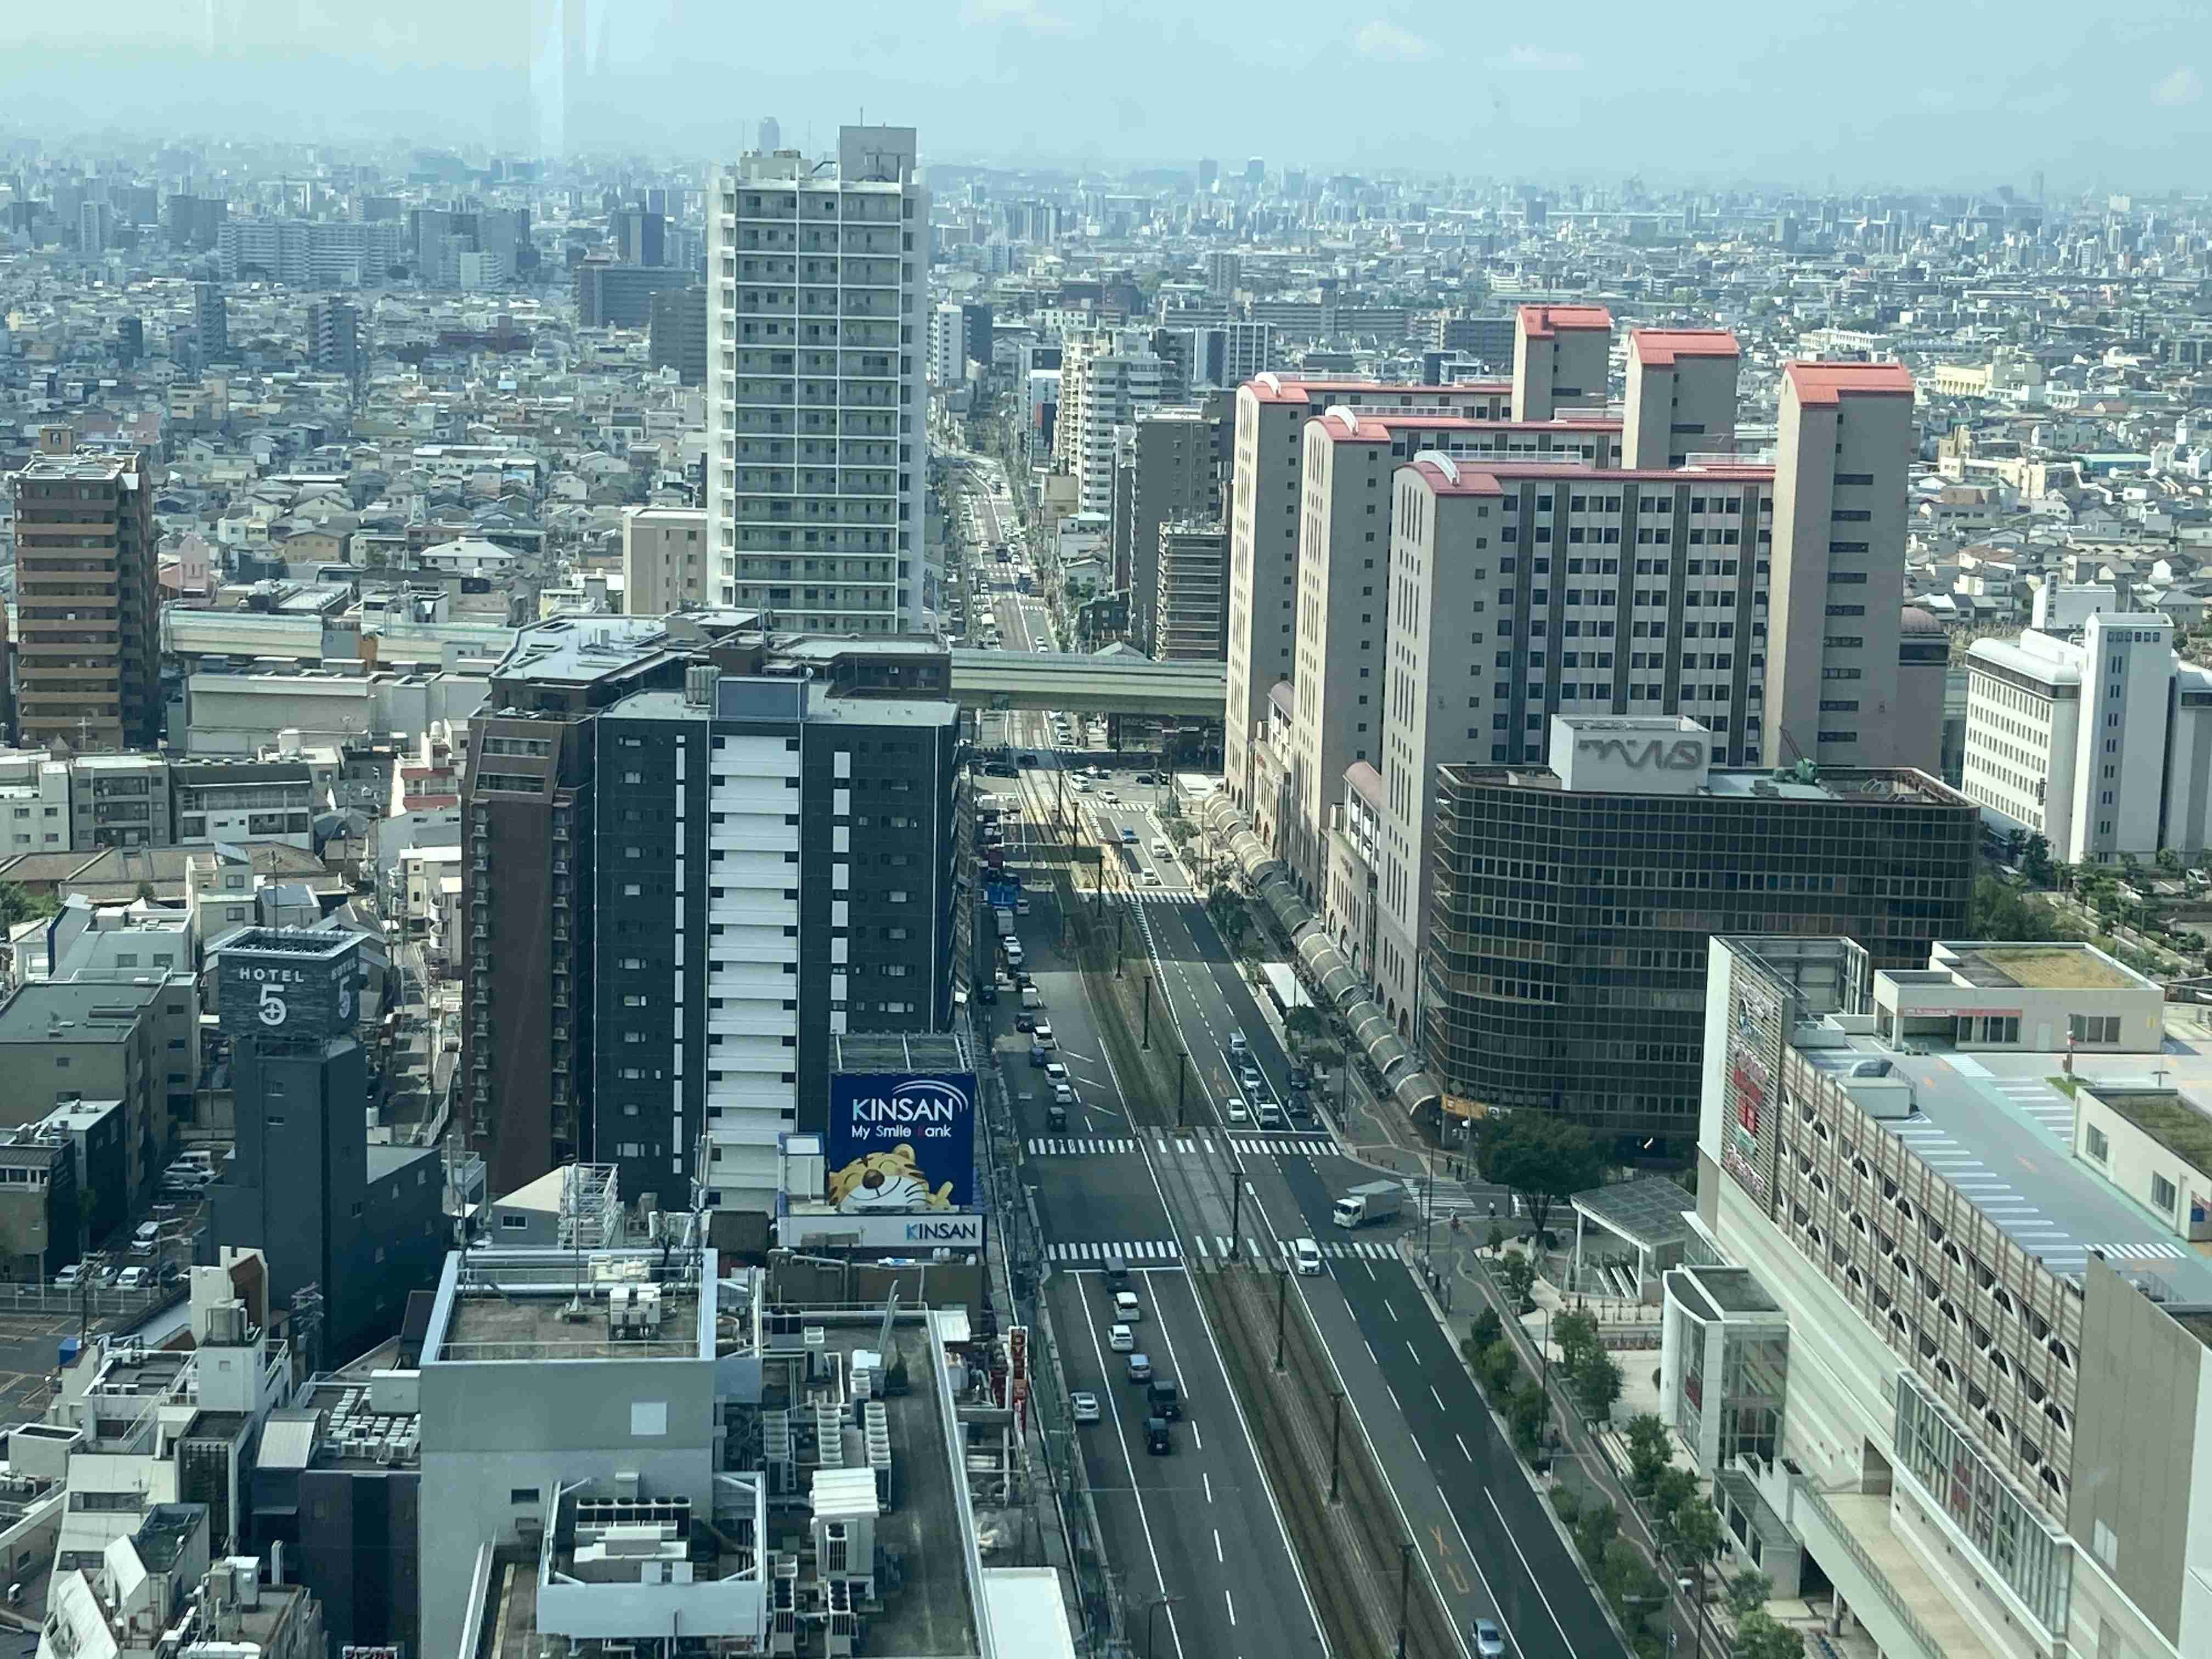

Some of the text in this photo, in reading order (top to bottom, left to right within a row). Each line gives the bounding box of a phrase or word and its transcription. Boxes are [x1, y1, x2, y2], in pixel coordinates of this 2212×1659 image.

[239, 967, 304, 983] HOTEL
[258, 984, 287, 1026] 5
[853, 1098, 953, 1121] KINSAN
[851, 1125, 871, 1140] My
[876, 1125, 911, 1138] Smile
[905, 1223, 976, 1240] KINSAN
